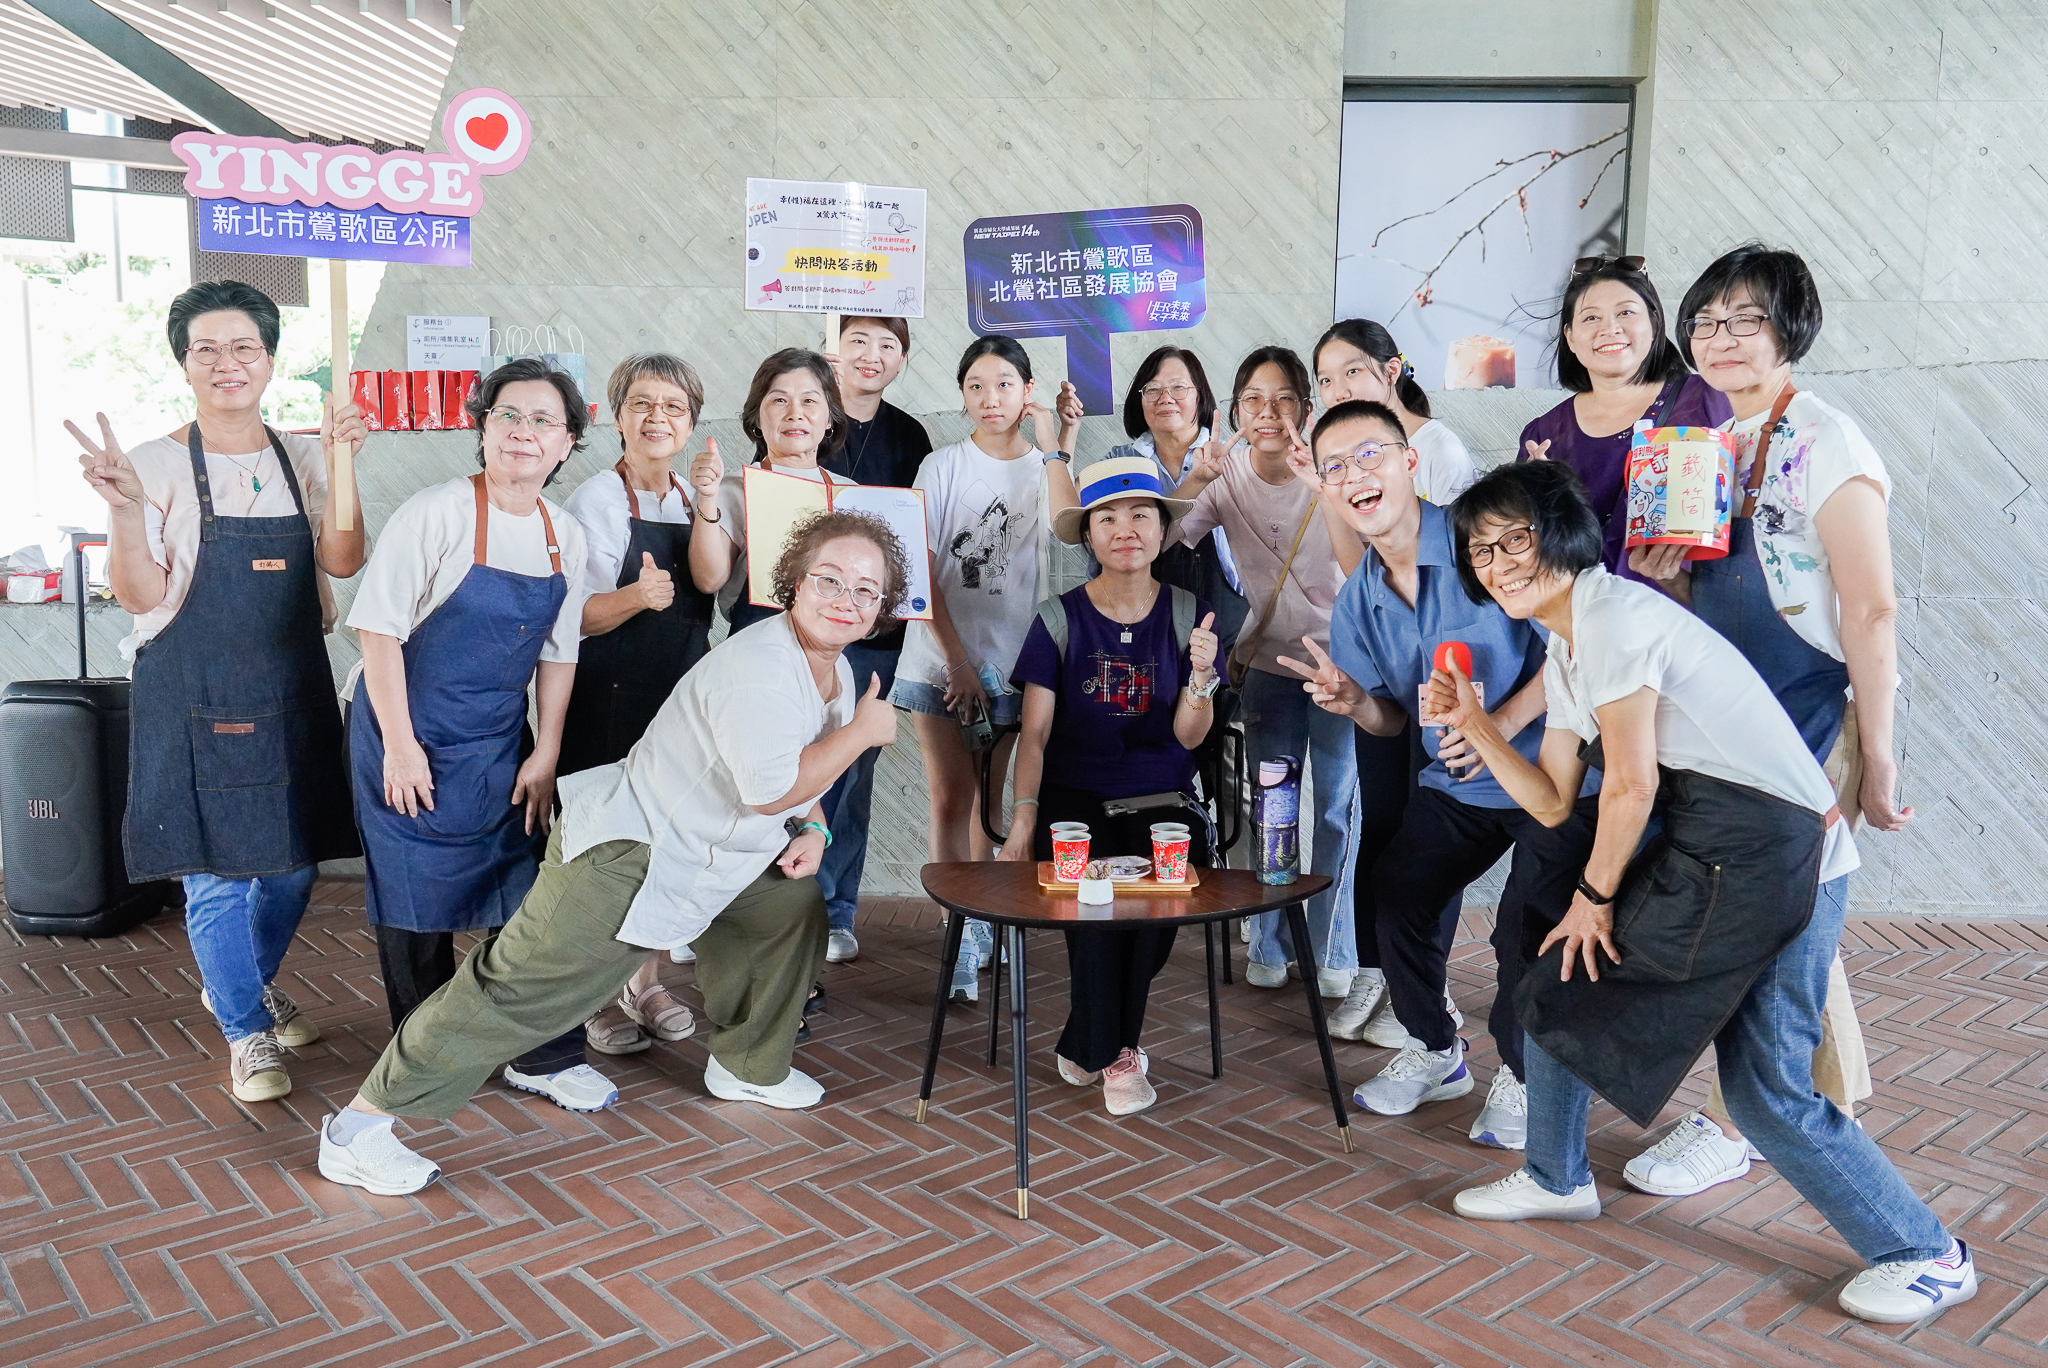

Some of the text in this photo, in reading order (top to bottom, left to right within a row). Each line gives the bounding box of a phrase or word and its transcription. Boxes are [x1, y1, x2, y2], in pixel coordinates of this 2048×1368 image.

[183, 143, 472, 207] YINGGE
[212, 204, 459, 249] 新北市鶯歌區公所
[1021, 223, 1040, 237] 14th
[794, 256, 878, 273] 快問快答活動
[1010, 244, 1154, 275] 新北市鶯歌區
[989, 269, 1179, 303] 北鶯社區發展協會
[28, 799, 60, 819] JBL
